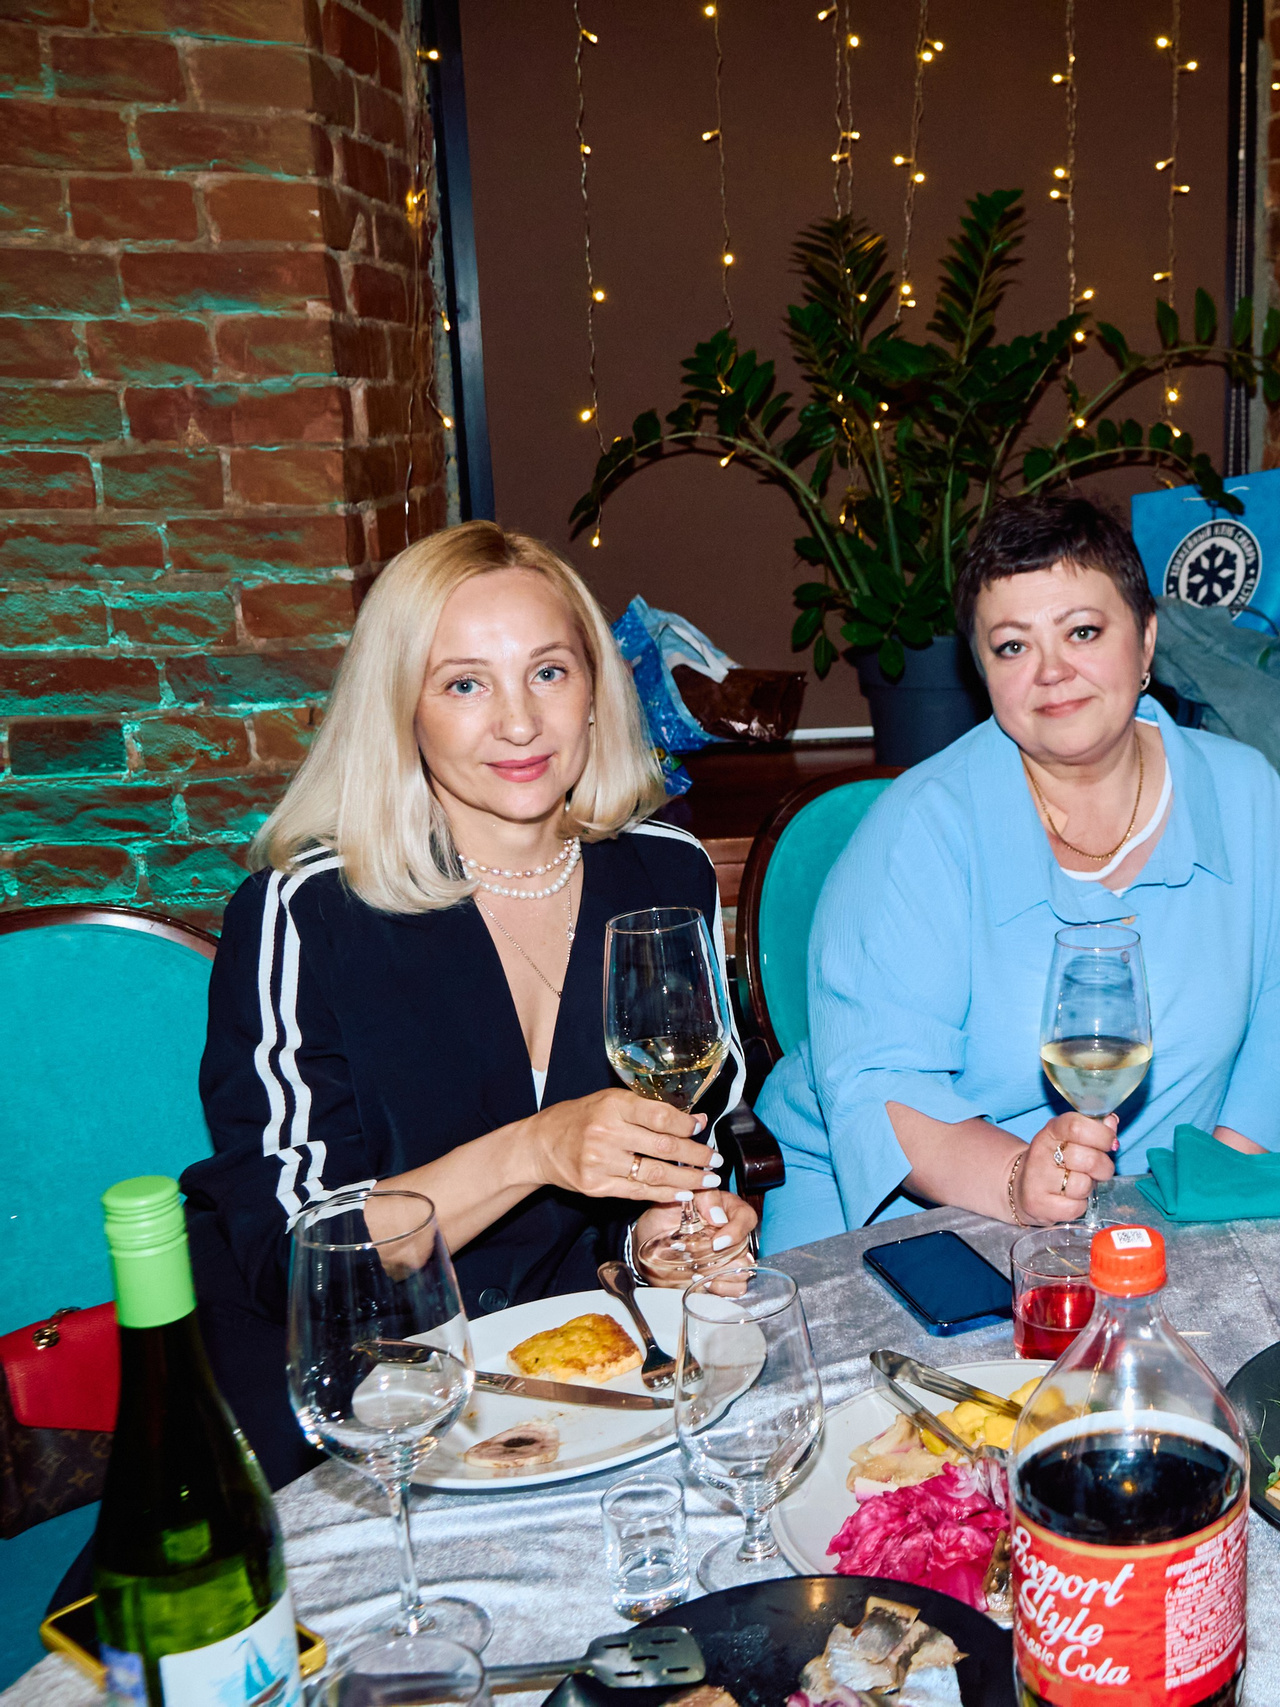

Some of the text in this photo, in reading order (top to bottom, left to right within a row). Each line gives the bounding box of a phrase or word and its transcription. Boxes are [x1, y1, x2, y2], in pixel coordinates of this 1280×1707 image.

[1012, 1525, 1135, 1607] Export
[1019, 1578, 1104, 1647] Style
[1057, 1644, 1131, 1686] Cola
